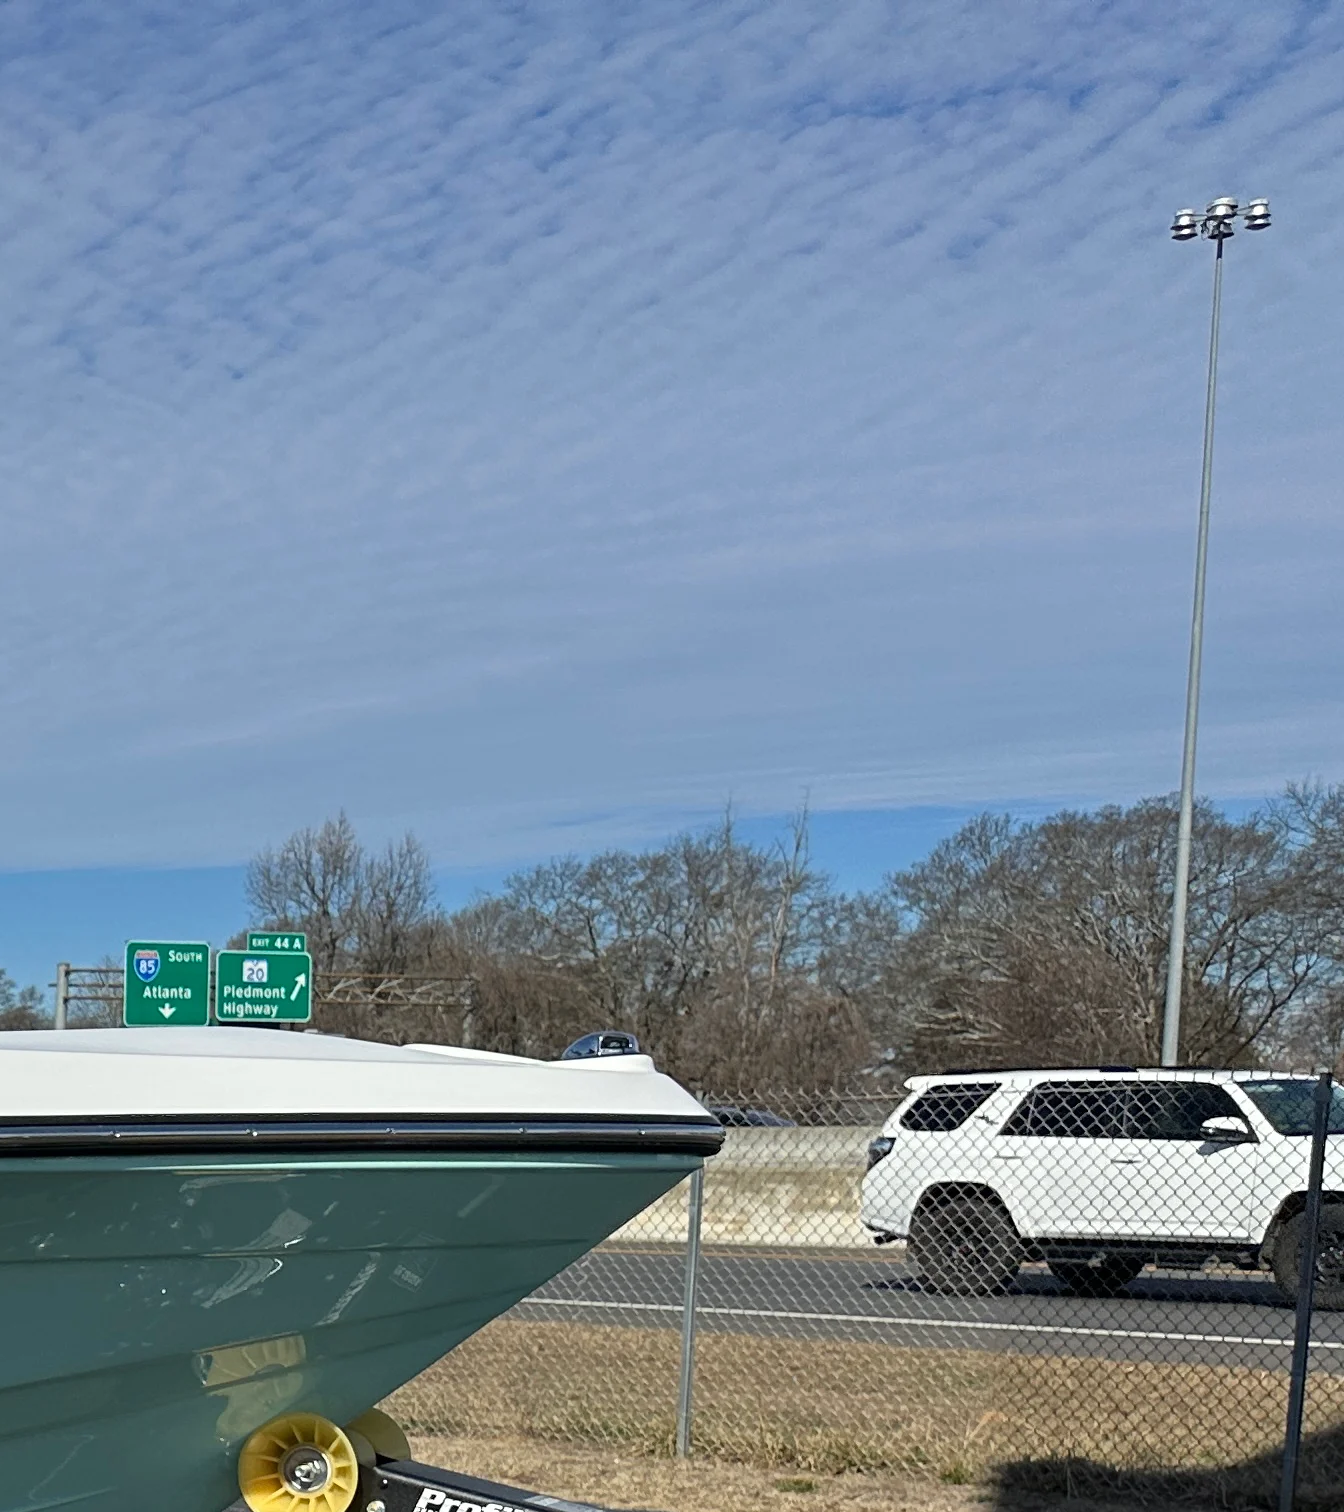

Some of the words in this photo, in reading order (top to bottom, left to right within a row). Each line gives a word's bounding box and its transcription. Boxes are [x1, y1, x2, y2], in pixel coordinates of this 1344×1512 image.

[252, 938, 270, 948] EXIT
[274, 937, 289, 949] 44
[292, 938, 302, 950] A
[168, 949, 203, 963] SOUTH
[139, 960, 156, 975] 85
[246, 967, 265, 981] 20
[142, 985, 192, 999] Atlanta
[223, 985, 286, 999] Piedmont
[223, 1001, 279, 1018] Highway
